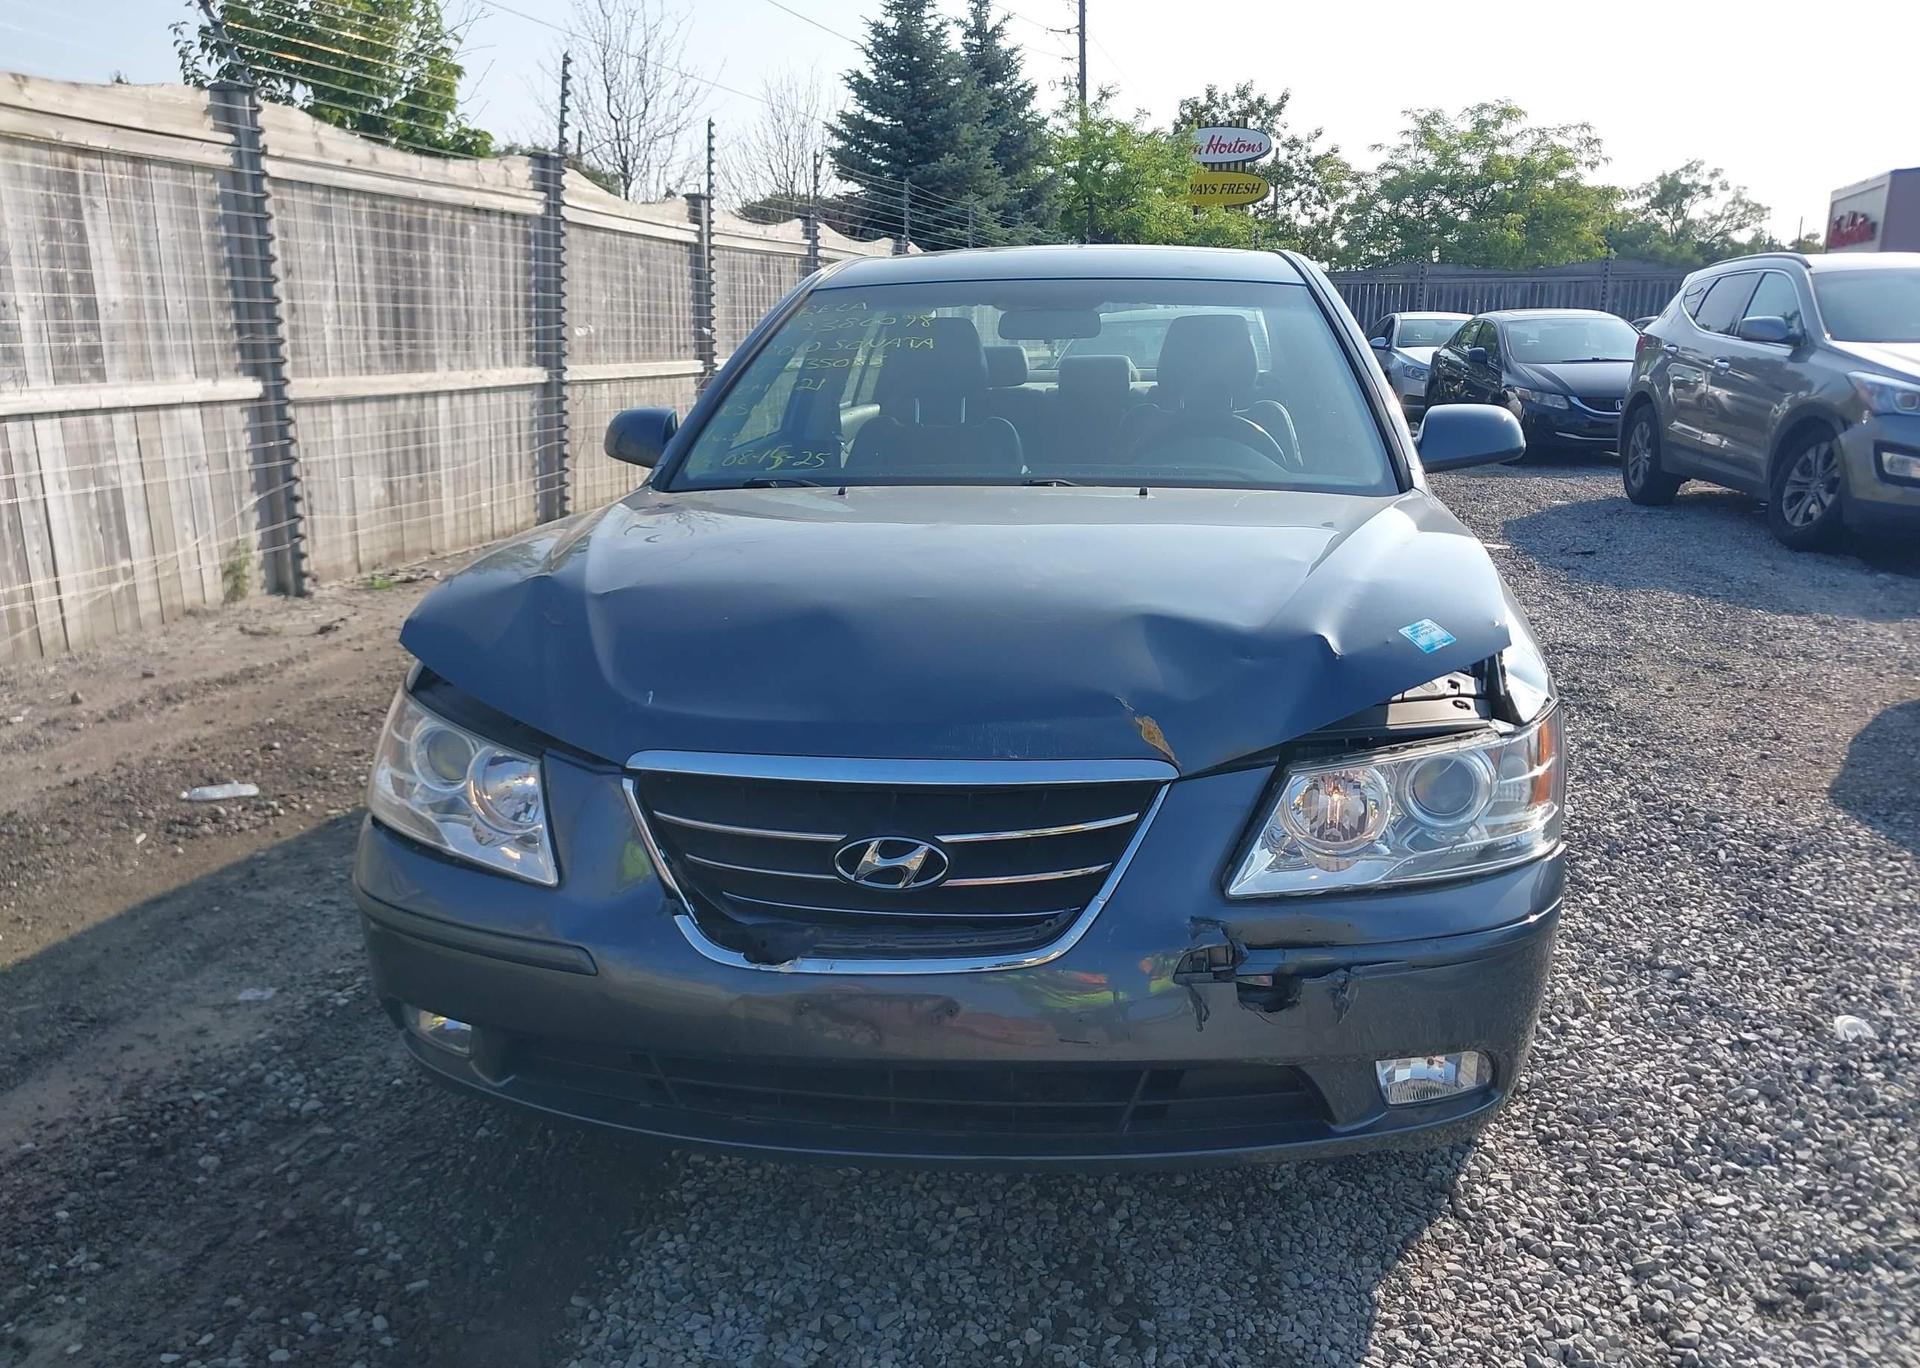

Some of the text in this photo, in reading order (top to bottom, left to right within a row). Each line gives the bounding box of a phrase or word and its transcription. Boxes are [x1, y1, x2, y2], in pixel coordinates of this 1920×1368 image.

[1205, 134, 1263, 155] Hortons
[1190, 182, 1262, 195] WAYS FRESH
[829, 336, 934, 351] SONATA
[721, 444, 832, 471] 08-15-25
